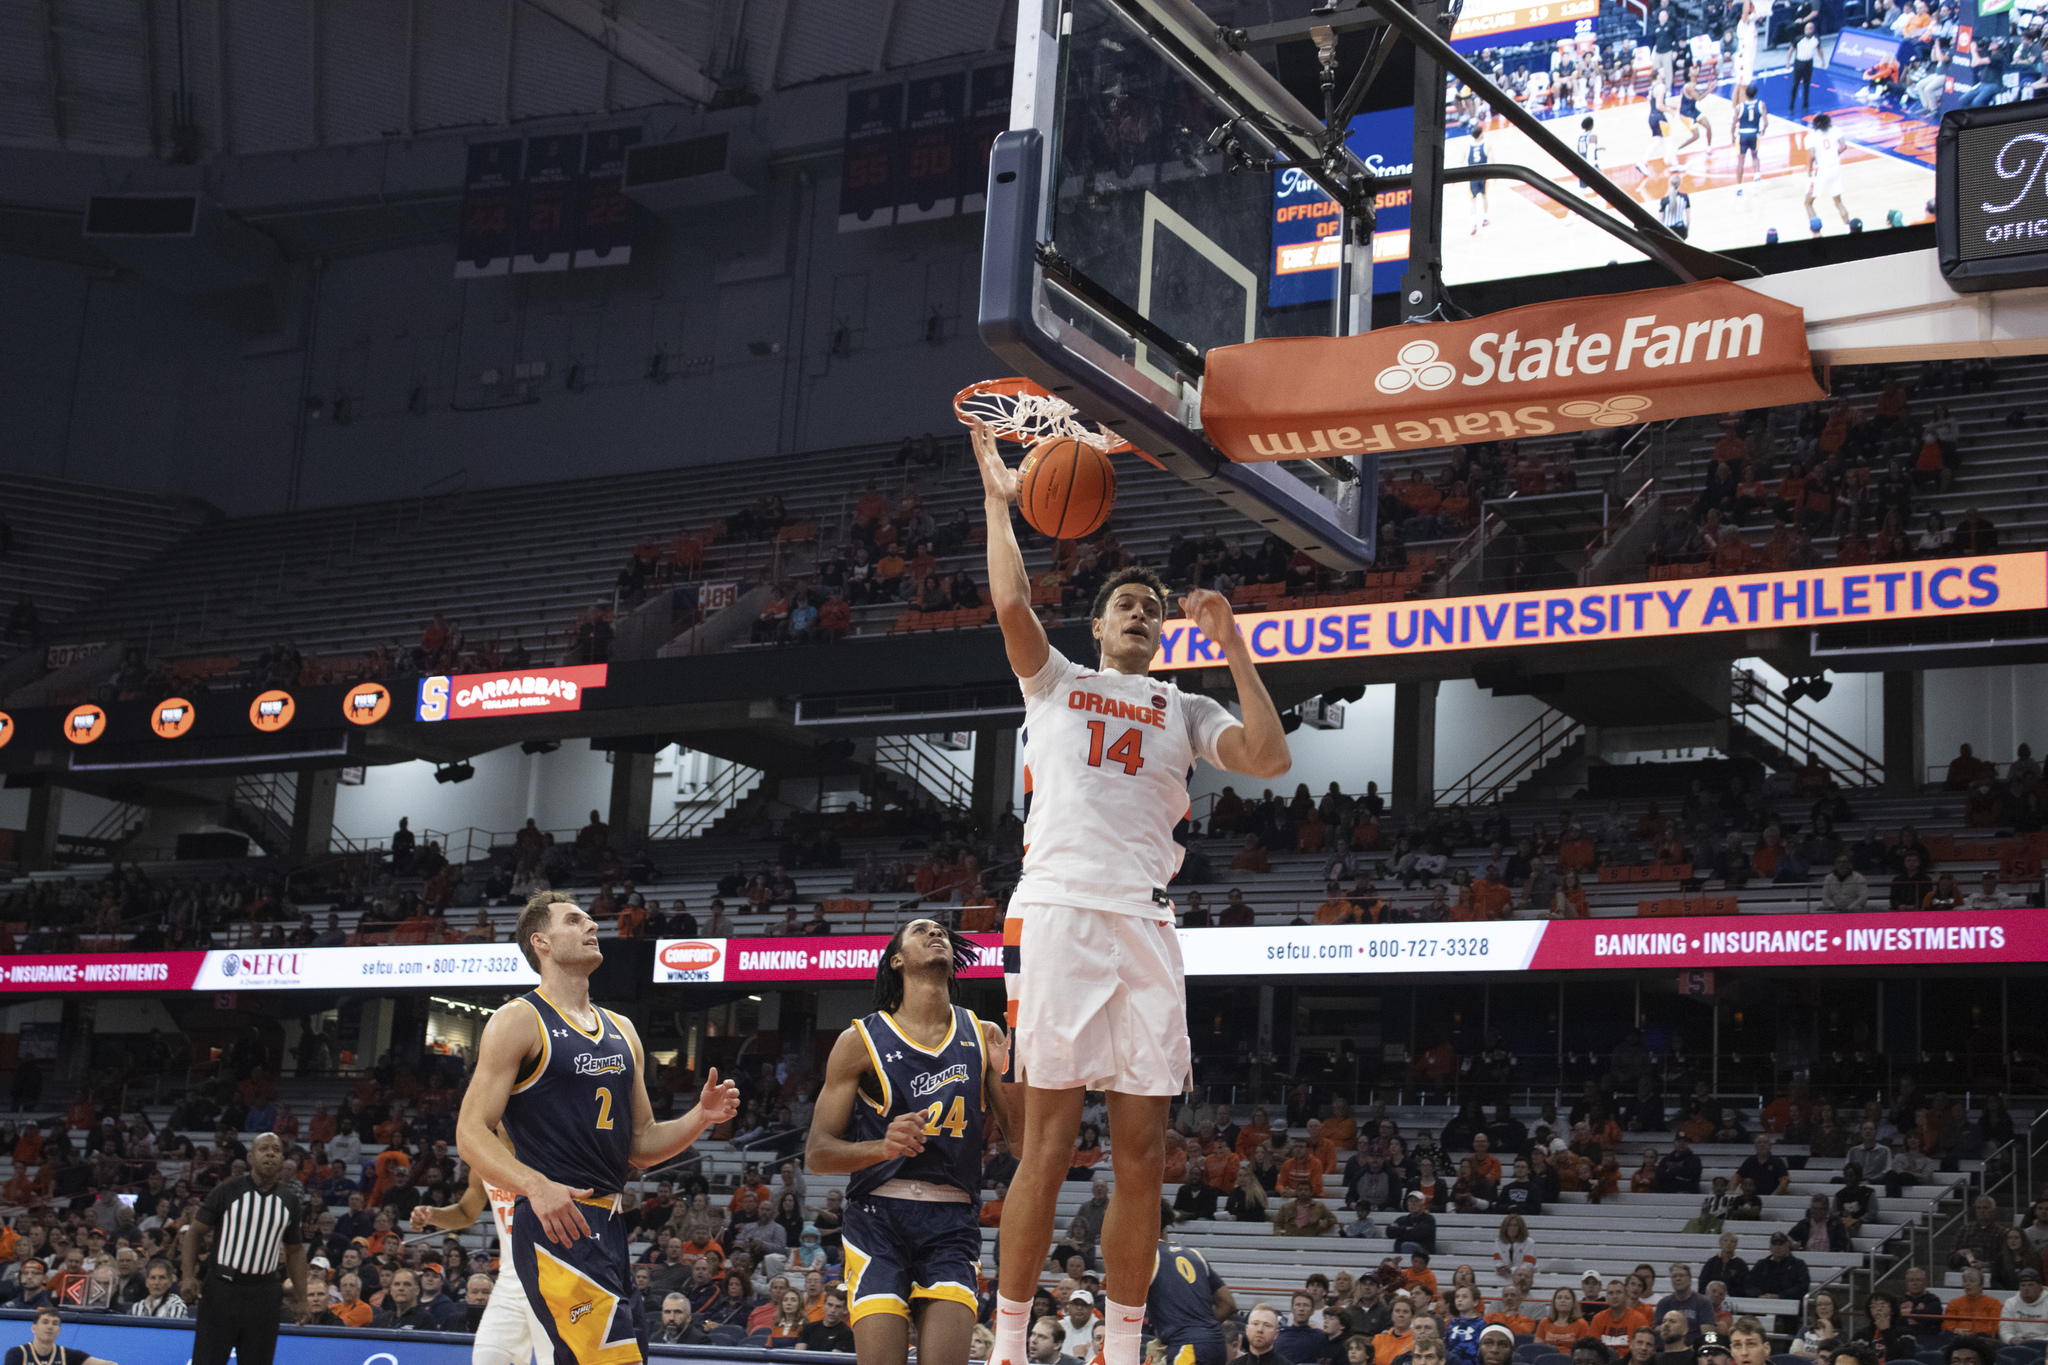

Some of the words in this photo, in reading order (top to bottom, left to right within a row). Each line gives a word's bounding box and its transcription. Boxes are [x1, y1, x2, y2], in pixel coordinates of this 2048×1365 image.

[1453, 12, 1516, 34] YRACUSE
[1529, 6, 1549, 22] 19
[1575, 19, 1592, 33] 22
[1276, 200, 1343, 223] OFFICIA
[1316, 221, 1339, 237] OF
[1387, 588, 1692, 648] UNIVERSITY
[1702, 564, 2000, 625] ATHLETICS
[456, 676, 577, 707] CARRABBA'S
[1068, 690, 1166, 730] ORANGE
[1087, 720, 1144, 776] 14
[1267, 942, 1353, 960] sefcu.com
[1368, 938, 1490, 958] 800-727-3328
[1594, 932, 1687, 956] BANKING
[1703, 930, 1828, 954] INSURANCE
[1846, 926, 2006, 951] INVESTMENTS
[241, 953, 306, 975] SEFCU
[362, 960, 423, 975] sefcu.com
[433, 957, 519, 974] 800-727-3328
[665, 948, 716, 963] COMFORT
[739, 950, 808, 970] BANKING
[819, 949, 885, 969] INSURA
[10, 965, 79, 983] INSURANCE
[84, 963, 169, 982] INVESTMENTS
[667, 970, 709, 981] WINDOWS
[594, 1086, 614, 1130] 2
[920, 1095, 968, 1138] 24
[1175, 1256, 1196, 1284] 0
